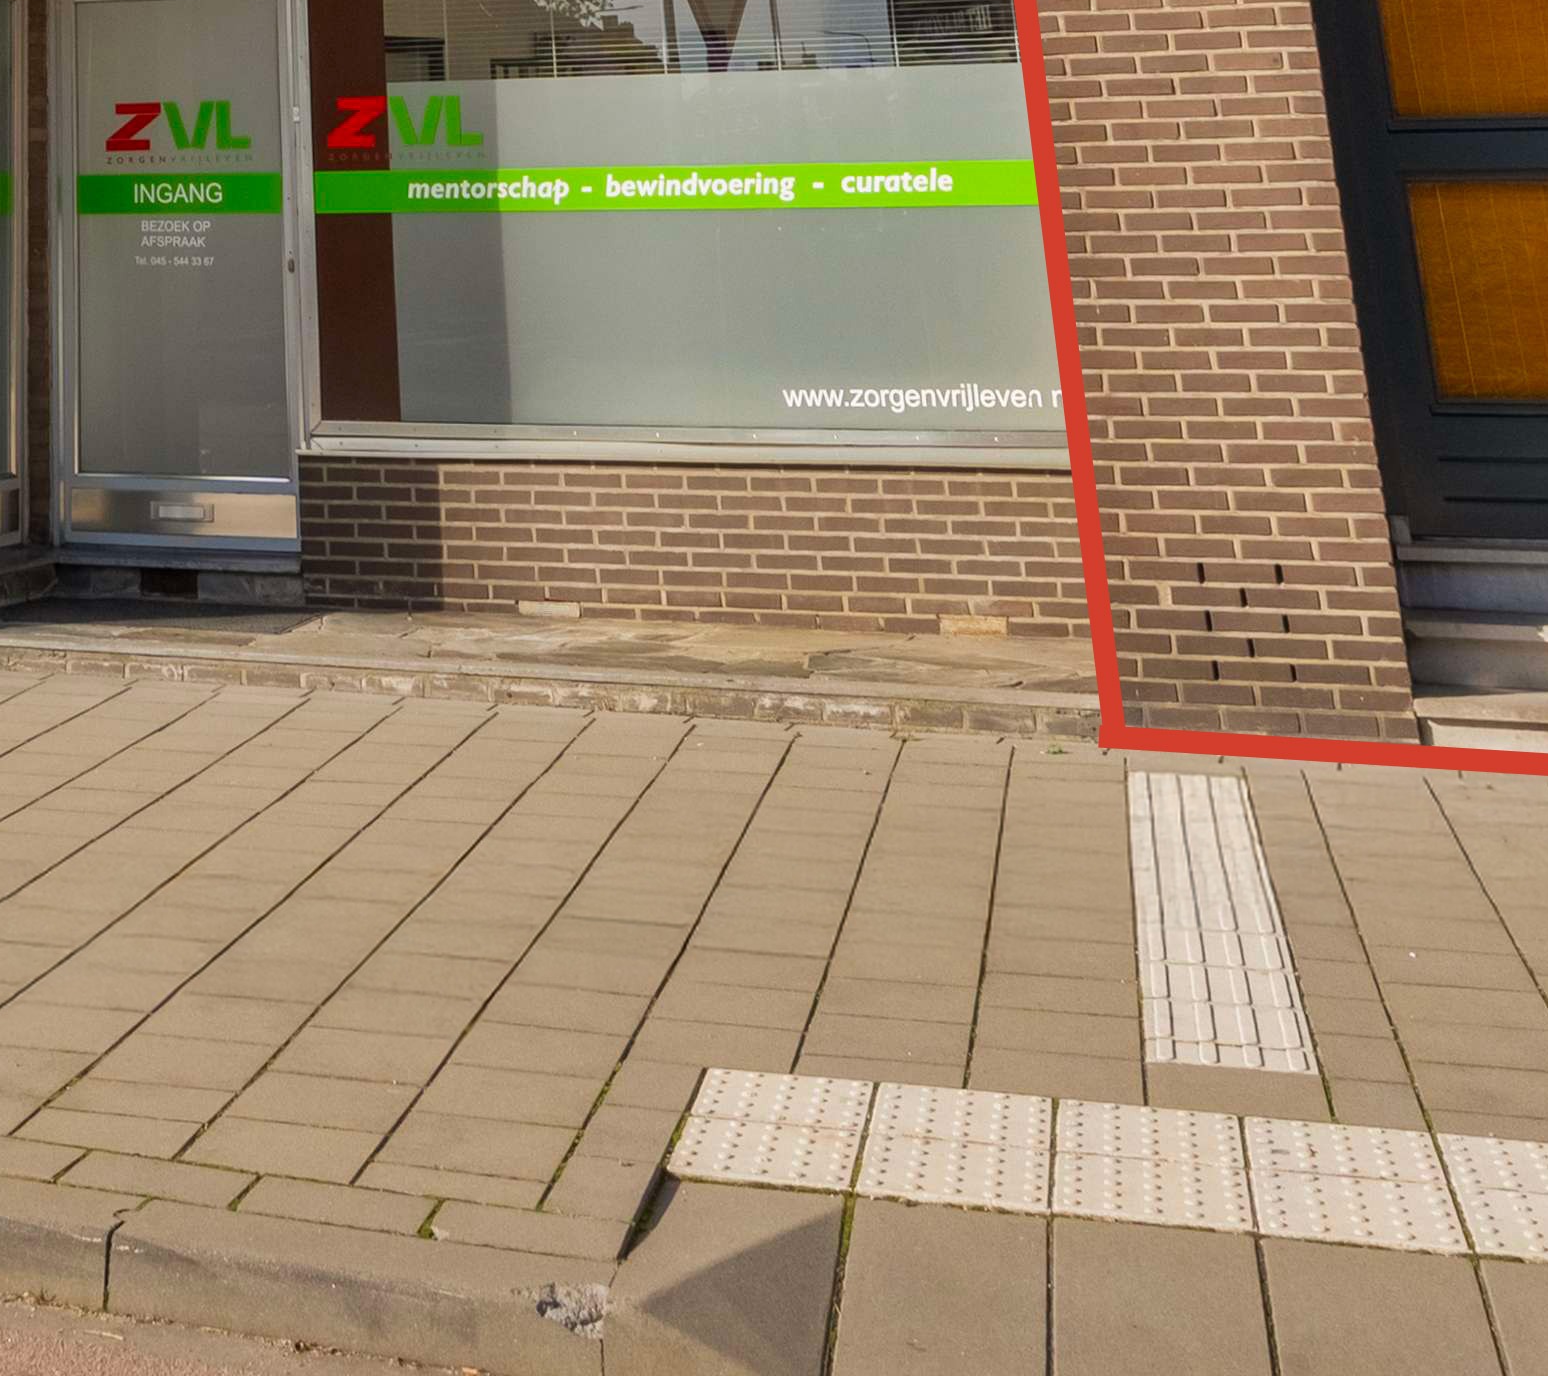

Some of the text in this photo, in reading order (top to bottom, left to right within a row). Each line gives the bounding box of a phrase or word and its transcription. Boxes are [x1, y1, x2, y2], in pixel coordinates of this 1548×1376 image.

[105, 101, 252, 152] ZVL
[328, 96, 484, 148] ZVL
[133, 182, 223, 204] INGANG
[408, 176, 570, 205] mentorschap
[605, 172, 796, 201] bewindvoering
[841, 168, 954, 194] curatele
[141, 220, 211, 232] BEZOEK OP
[140, 236, 206, 248] AFSPRAAK
[150, 256, 167, 266] 045
